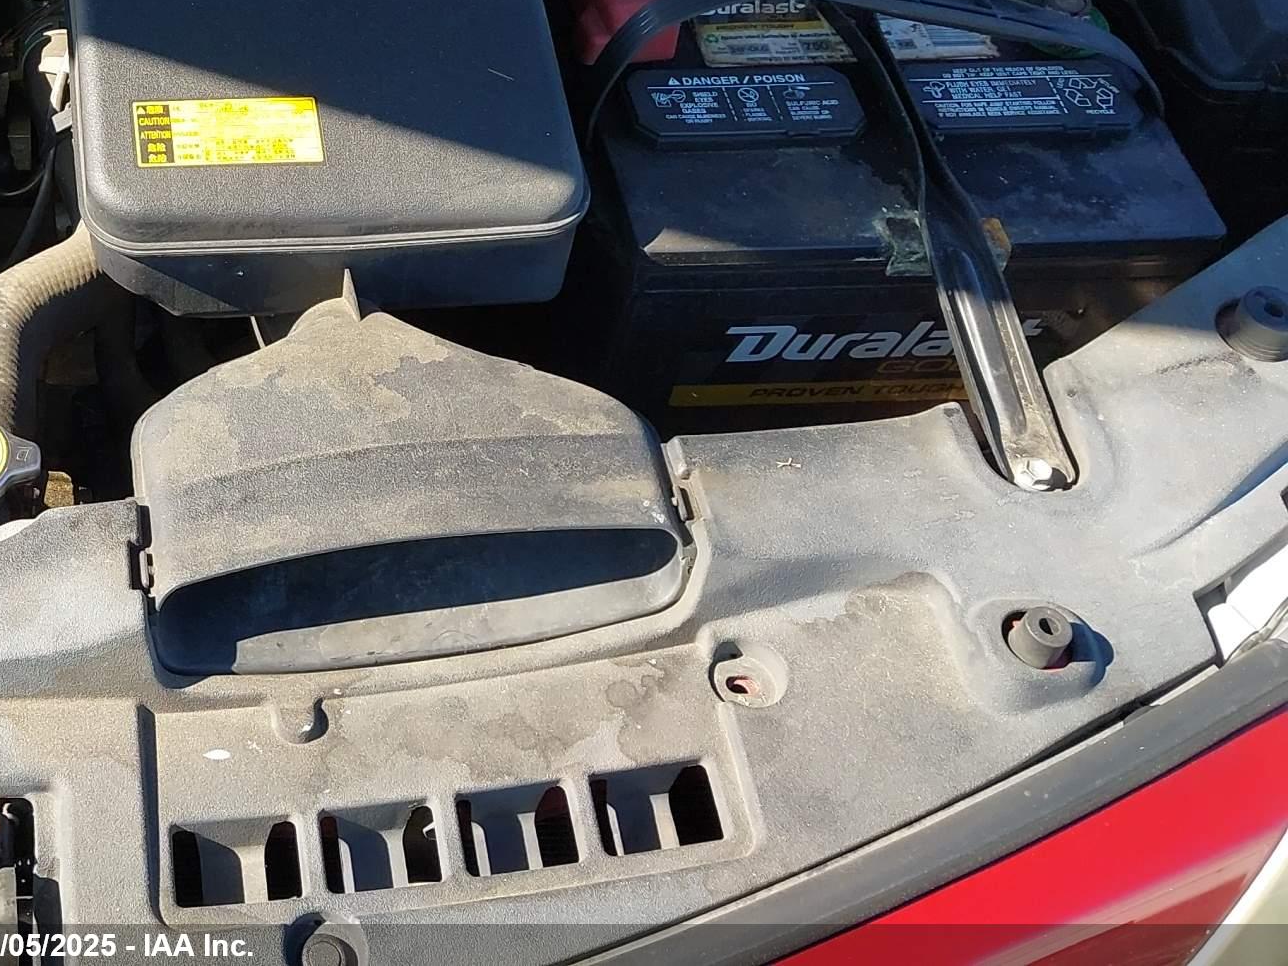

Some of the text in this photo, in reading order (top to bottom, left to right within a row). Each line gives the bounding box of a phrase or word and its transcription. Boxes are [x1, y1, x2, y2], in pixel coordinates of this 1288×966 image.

[682, 74, 806, 85] DANGER / POISON
[139, 116, 171, 126] CAUTION
[140, 130, 172, 140] ATTENTION
[748, 384, 865, 398] PROVEN
